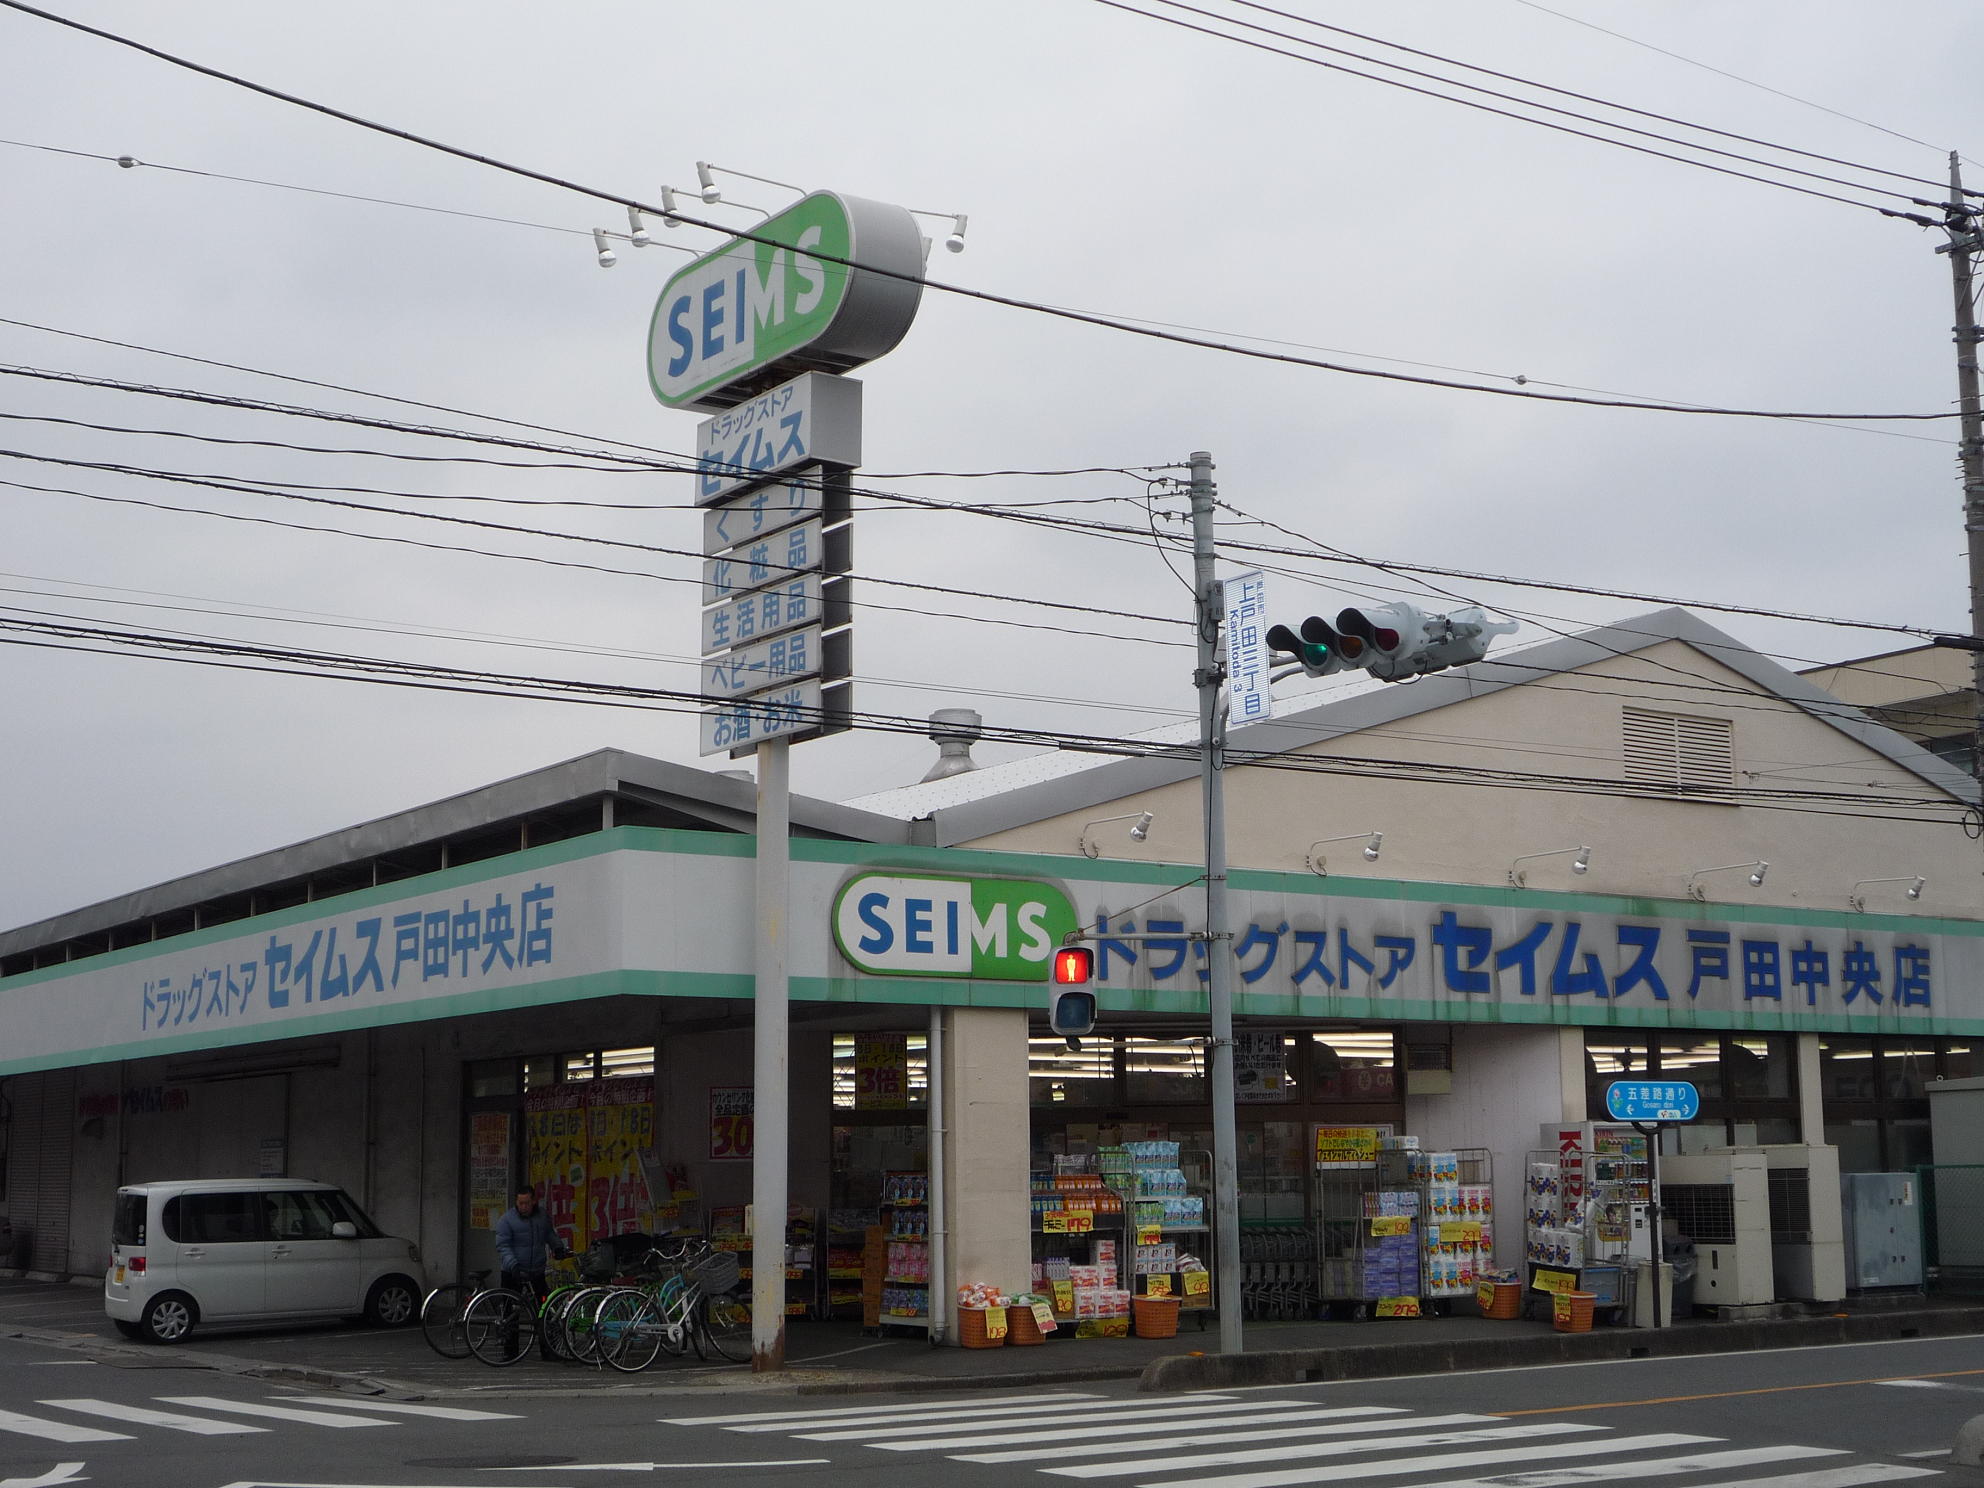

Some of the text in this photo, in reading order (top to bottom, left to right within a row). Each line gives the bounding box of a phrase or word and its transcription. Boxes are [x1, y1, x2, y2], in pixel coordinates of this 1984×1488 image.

[667, 225, 826, 378] SEIMS
[711, 385, 793, 446] ドラッグストア
[701, 410, 805, 496] セイムス
[716, 478, 806, 543] くすり
[713, 528, 806, 597] 化粧品
[712, 581, 806, 647] 生活用品
[1239, 582, 1261, 714] 上戸田三丁目
[711, 634, 806, 689] ベビー用品
[1230, 609, 1243, 693] Kamitoda 3
[713, 688, 803, 747] お酒・お米
[142, 883, 555, 1031] ドラッグストア セイムス 戸田中央店
[858, 892, 1052, 963] SEIMS
[1432, 911, 1669, 1000] セイムス
[1687, 928, 1932, 1007] 戸田中央店
